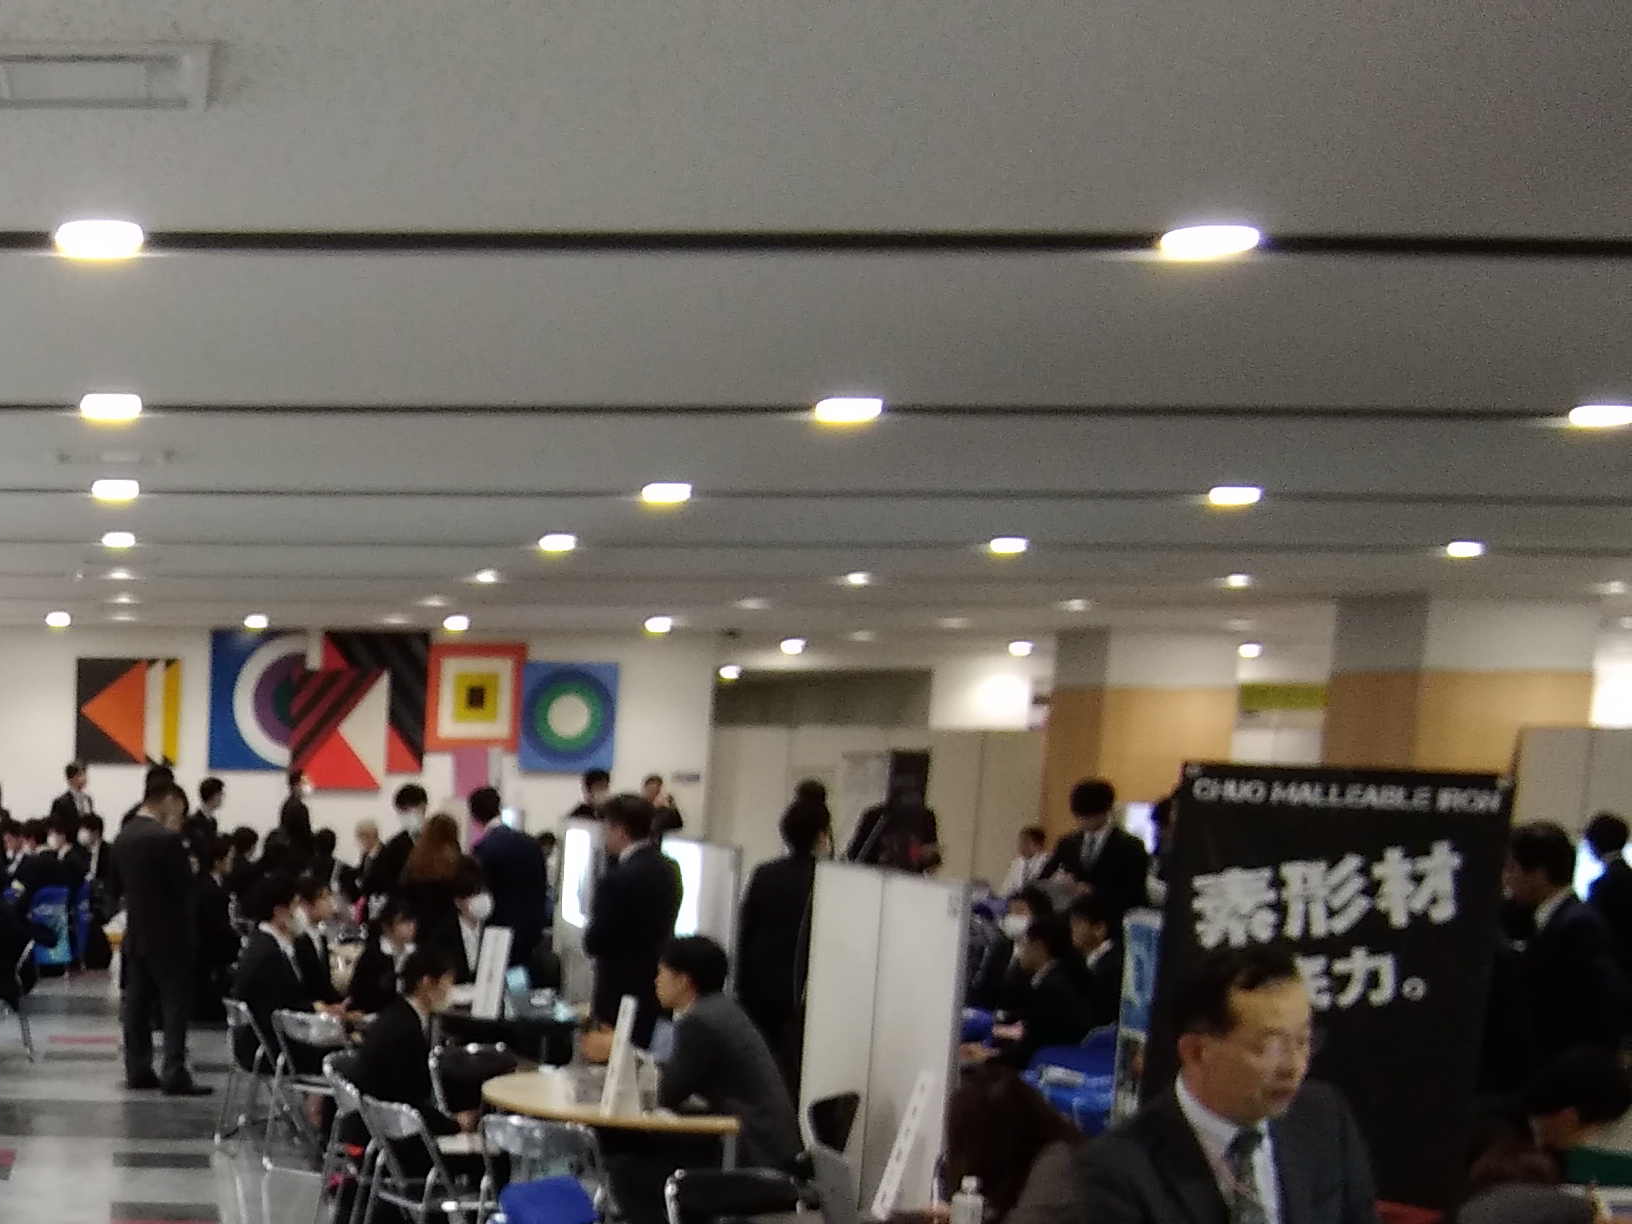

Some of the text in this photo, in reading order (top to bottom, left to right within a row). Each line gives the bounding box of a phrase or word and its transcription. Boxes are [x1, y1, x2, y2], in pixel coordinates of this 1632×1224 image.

[1192, 774, 1503, 815] CHUO MALLEABLE IRON
[1190, 839, 1465, 951] 素形材
